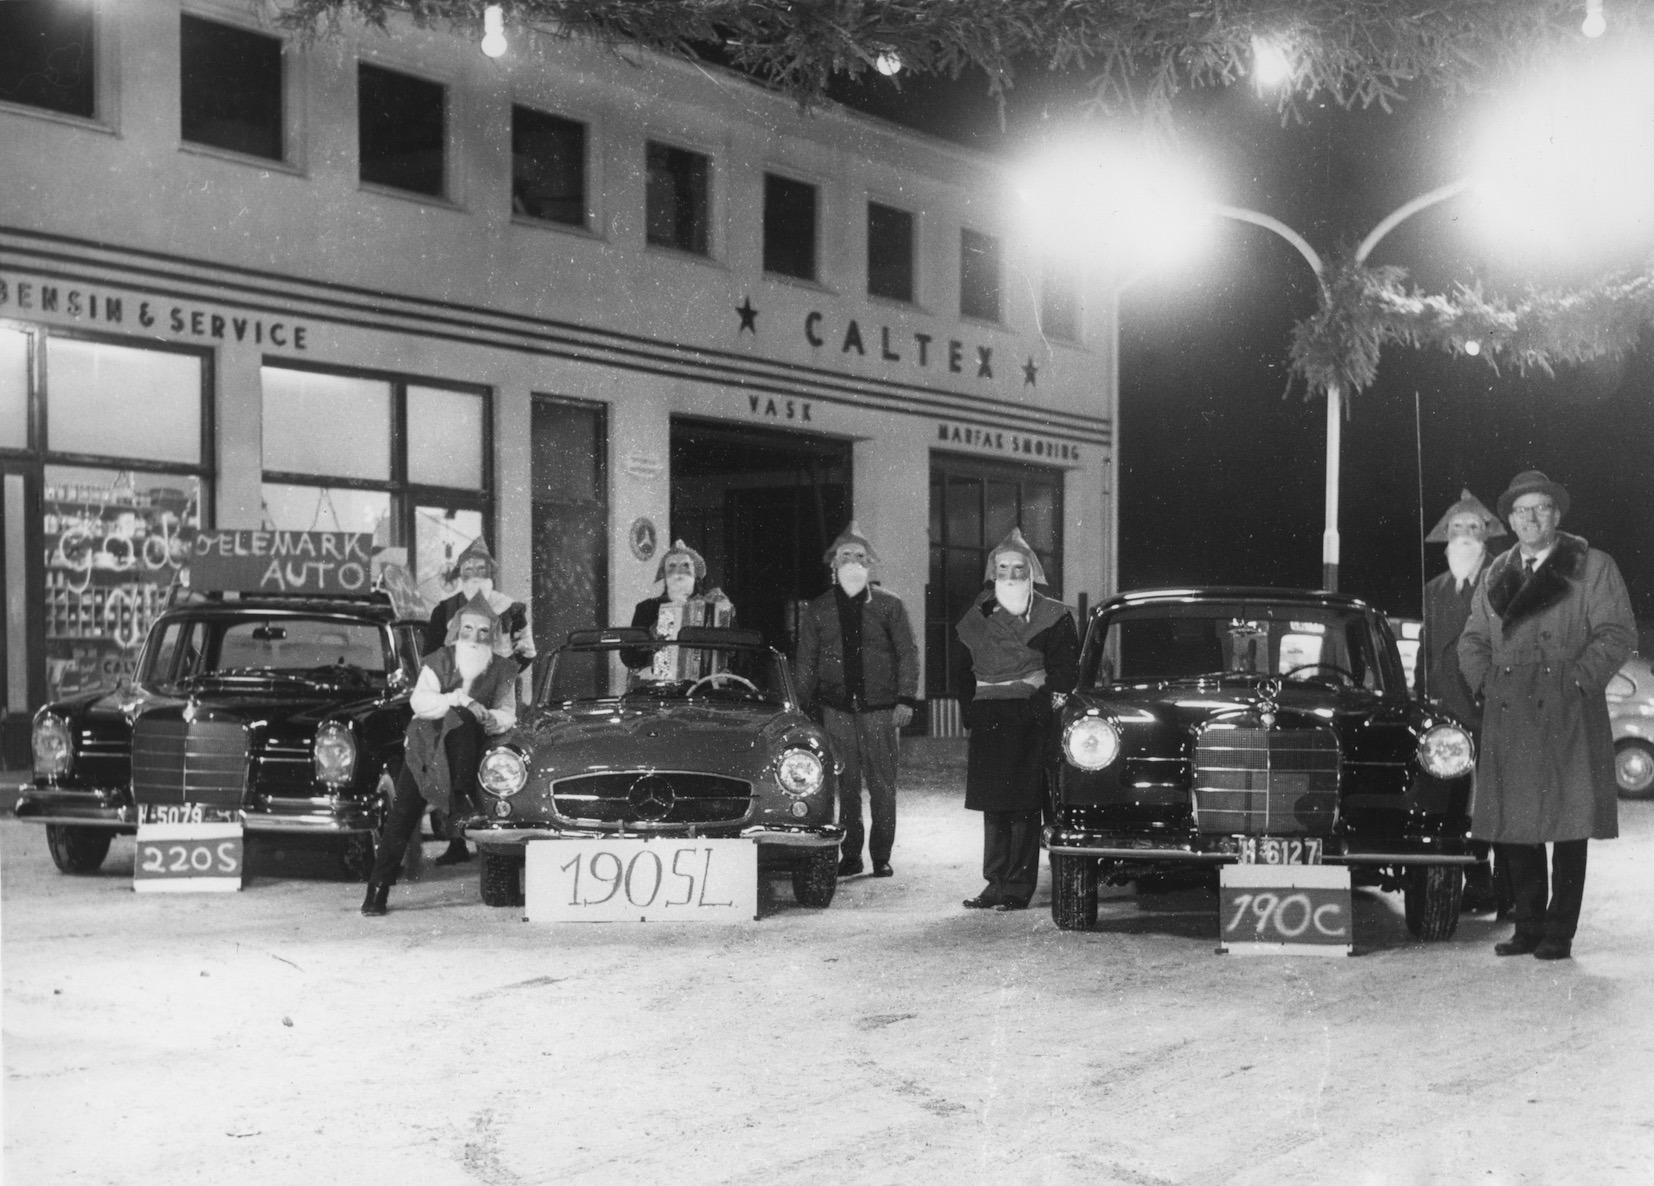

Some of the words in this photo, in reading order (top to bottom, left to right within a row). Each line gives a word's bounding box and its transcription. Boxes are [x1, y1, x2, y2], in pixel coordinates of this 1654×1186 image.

[139, 302, 154, 327] &
[170, 307, 307, 349] SERVICE
[805, 311, 993, 378] CALTEX
[749, 394, 812, 421] VASK
[260, 559, 365, 591] AUTO
[142, 842, 237, 873] 220S
[560, 847, 734, 908] 190SL
